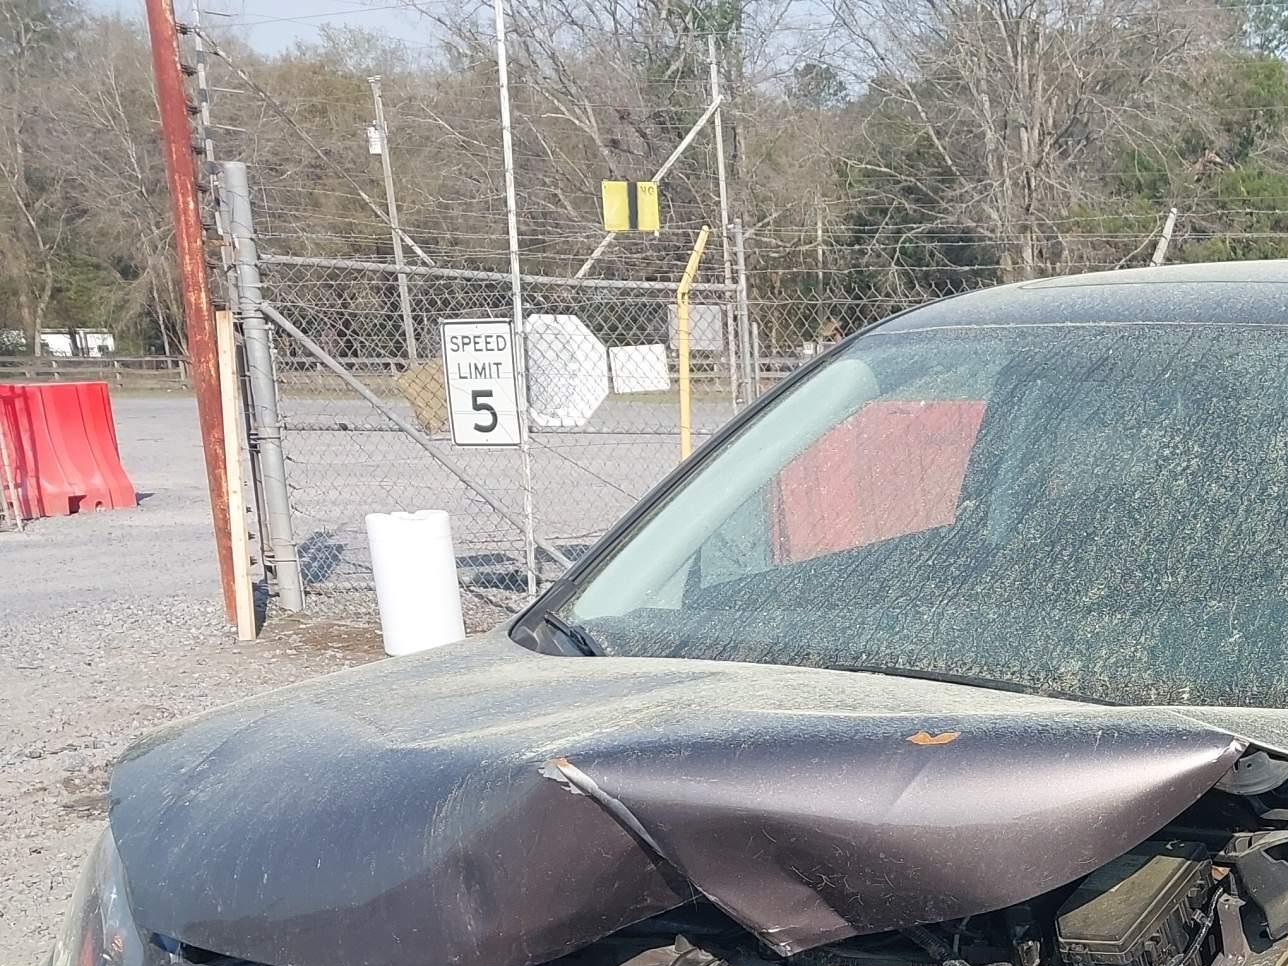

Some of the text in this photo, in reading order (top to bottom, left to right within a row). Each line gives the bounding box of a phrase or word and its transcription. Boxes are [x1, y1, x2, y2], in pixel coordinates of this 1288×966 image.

[450, 334, 507, 353] SPEED
[457, 362, 502, 379] LIMIT
[471, 390, 498, 433] 5
